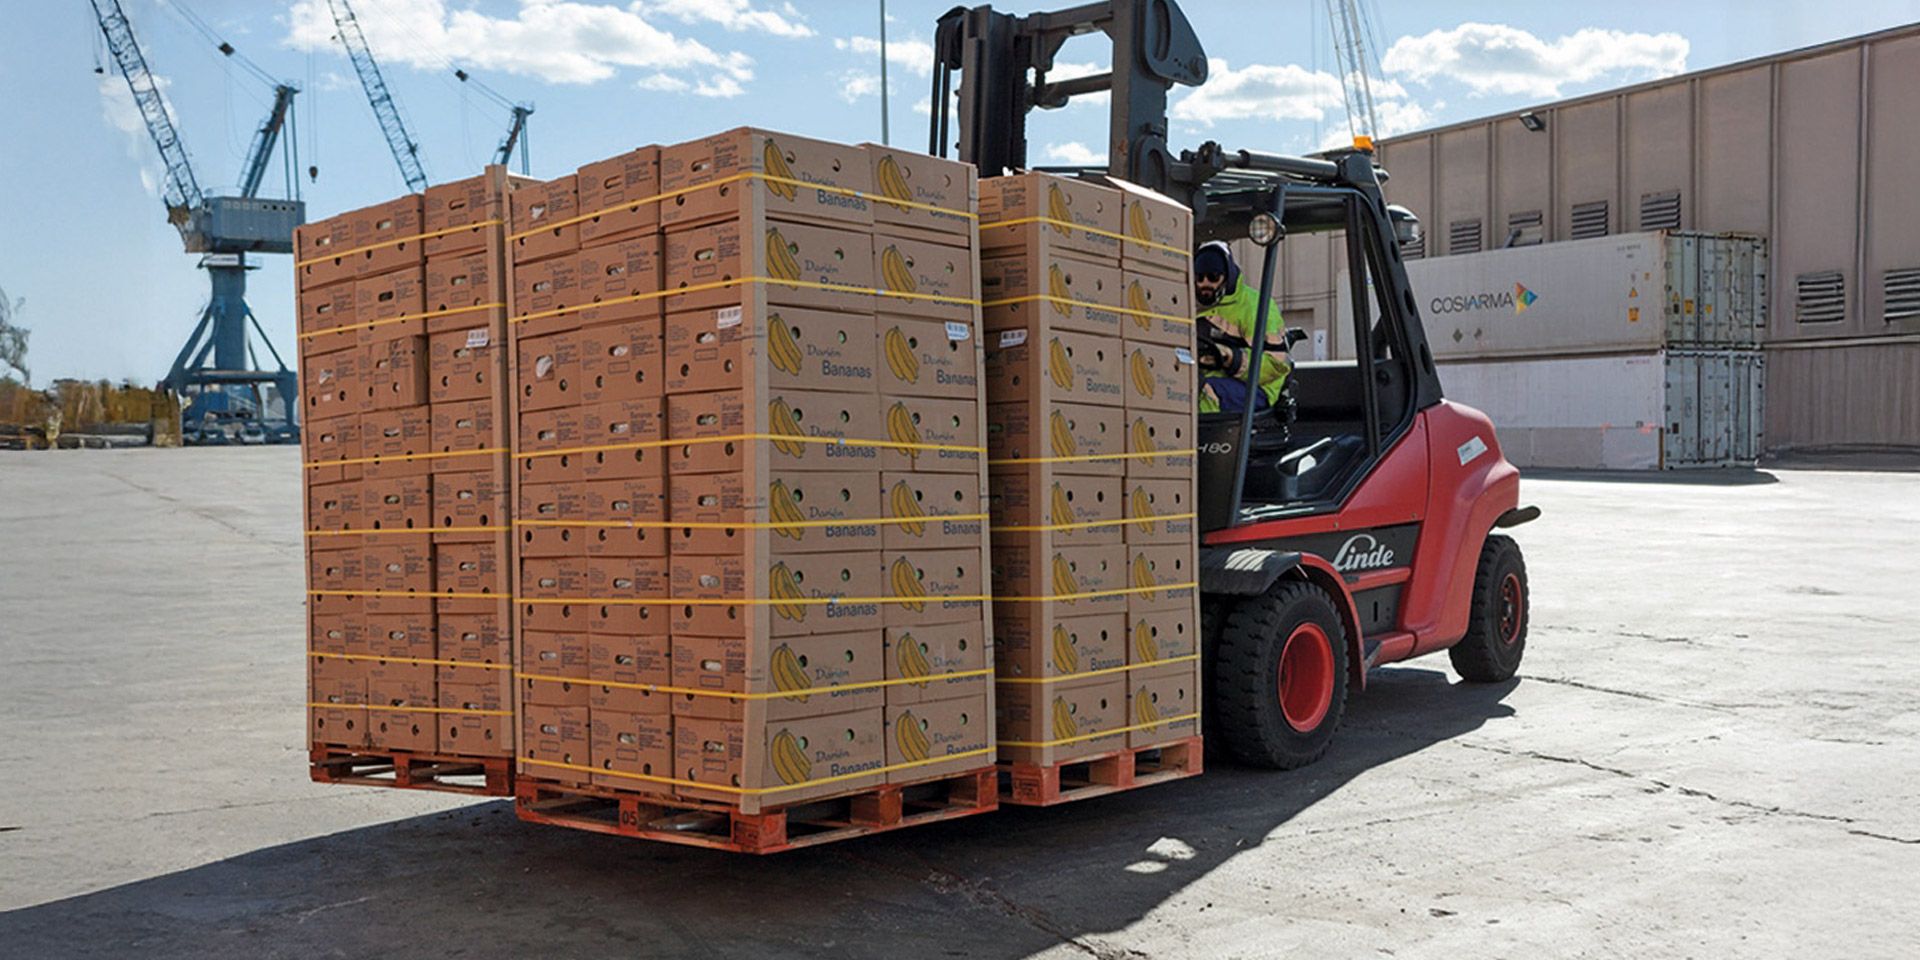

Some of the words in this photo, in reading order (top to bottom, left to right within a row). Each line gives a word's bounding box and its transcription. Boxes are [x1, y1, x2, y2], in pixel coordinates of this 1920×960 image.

[1431, 292, 1514, 314] COSIARMA
[822, 360, 872, 379] Bananas
[1331, 533, 1394, 572] Linde
[826, 602, 877, 618] Bananas
[623, 810, 638, 826] 05
